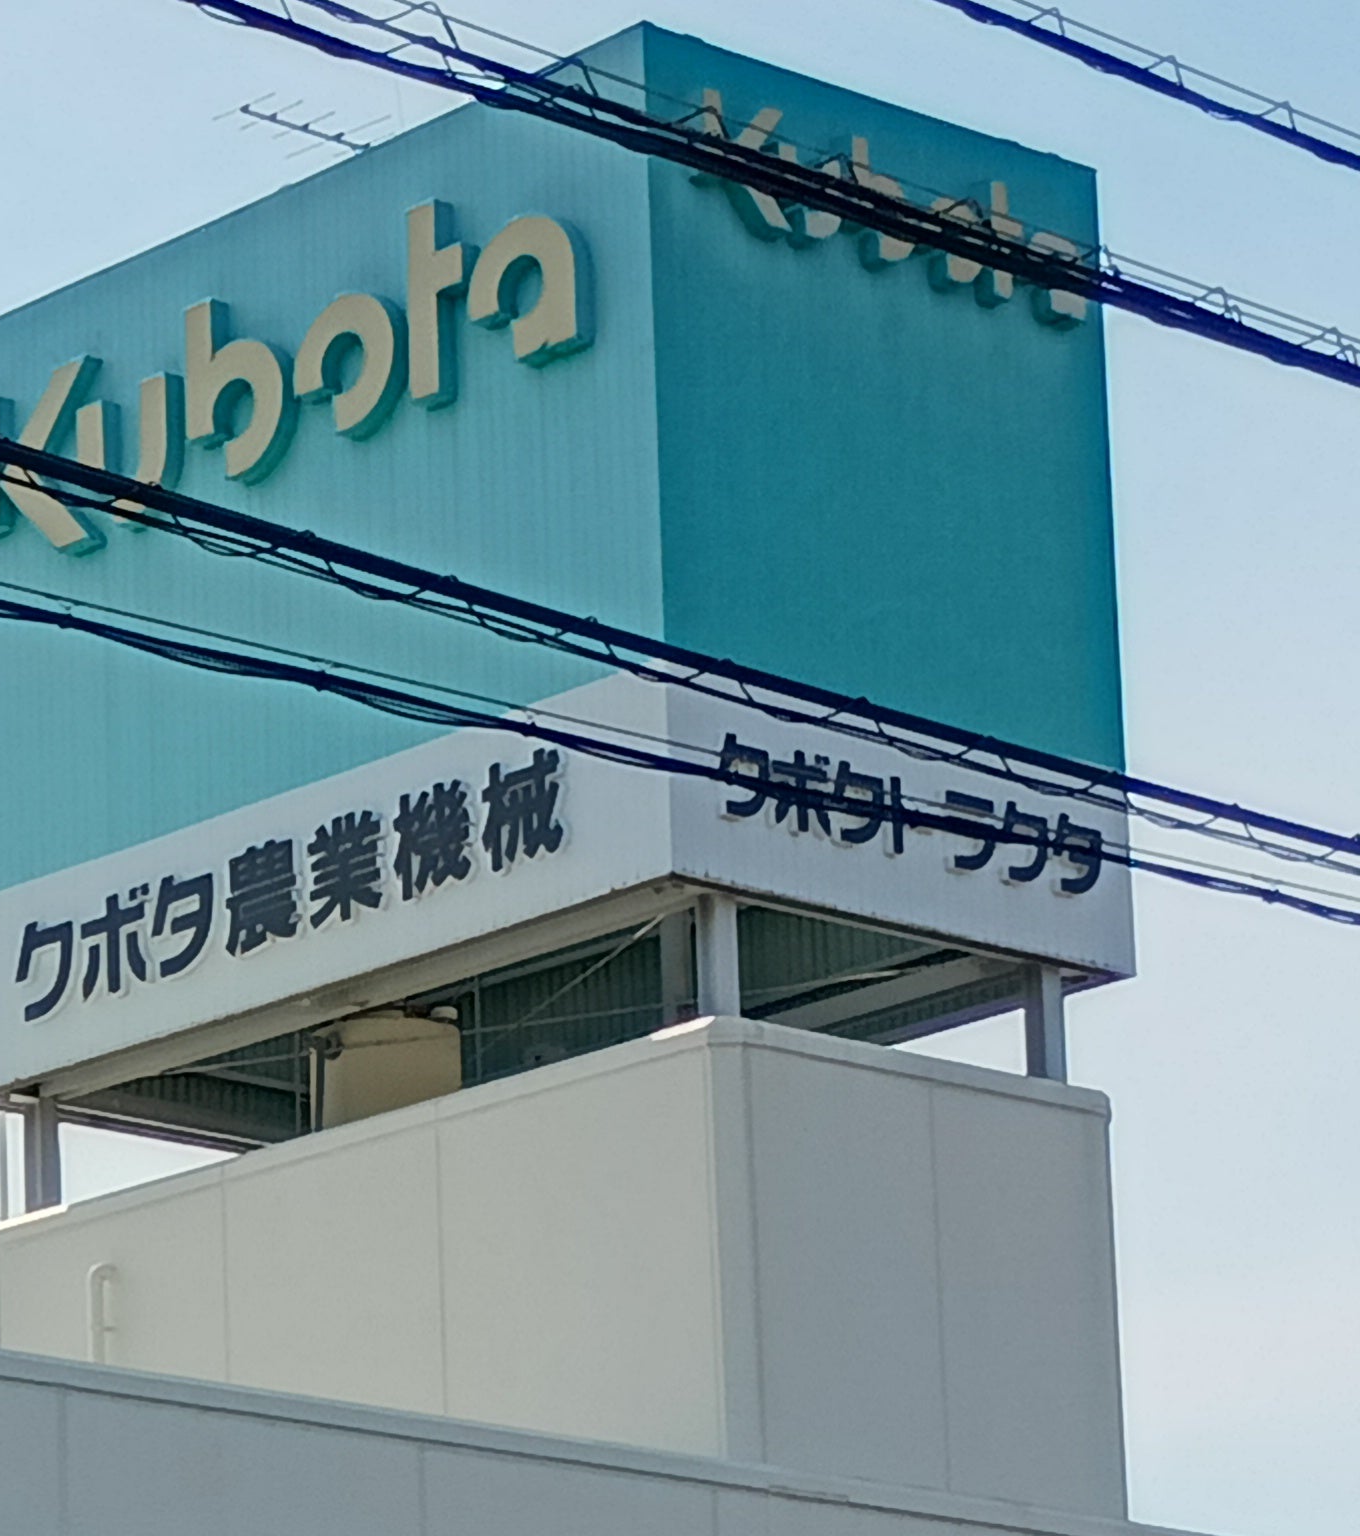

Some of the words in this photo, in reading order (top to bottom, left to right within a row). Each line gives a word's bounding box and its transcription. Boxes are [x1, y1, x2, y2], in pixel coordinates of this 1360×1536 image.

[14, 747, 565, 1022] クボタ農業機械
